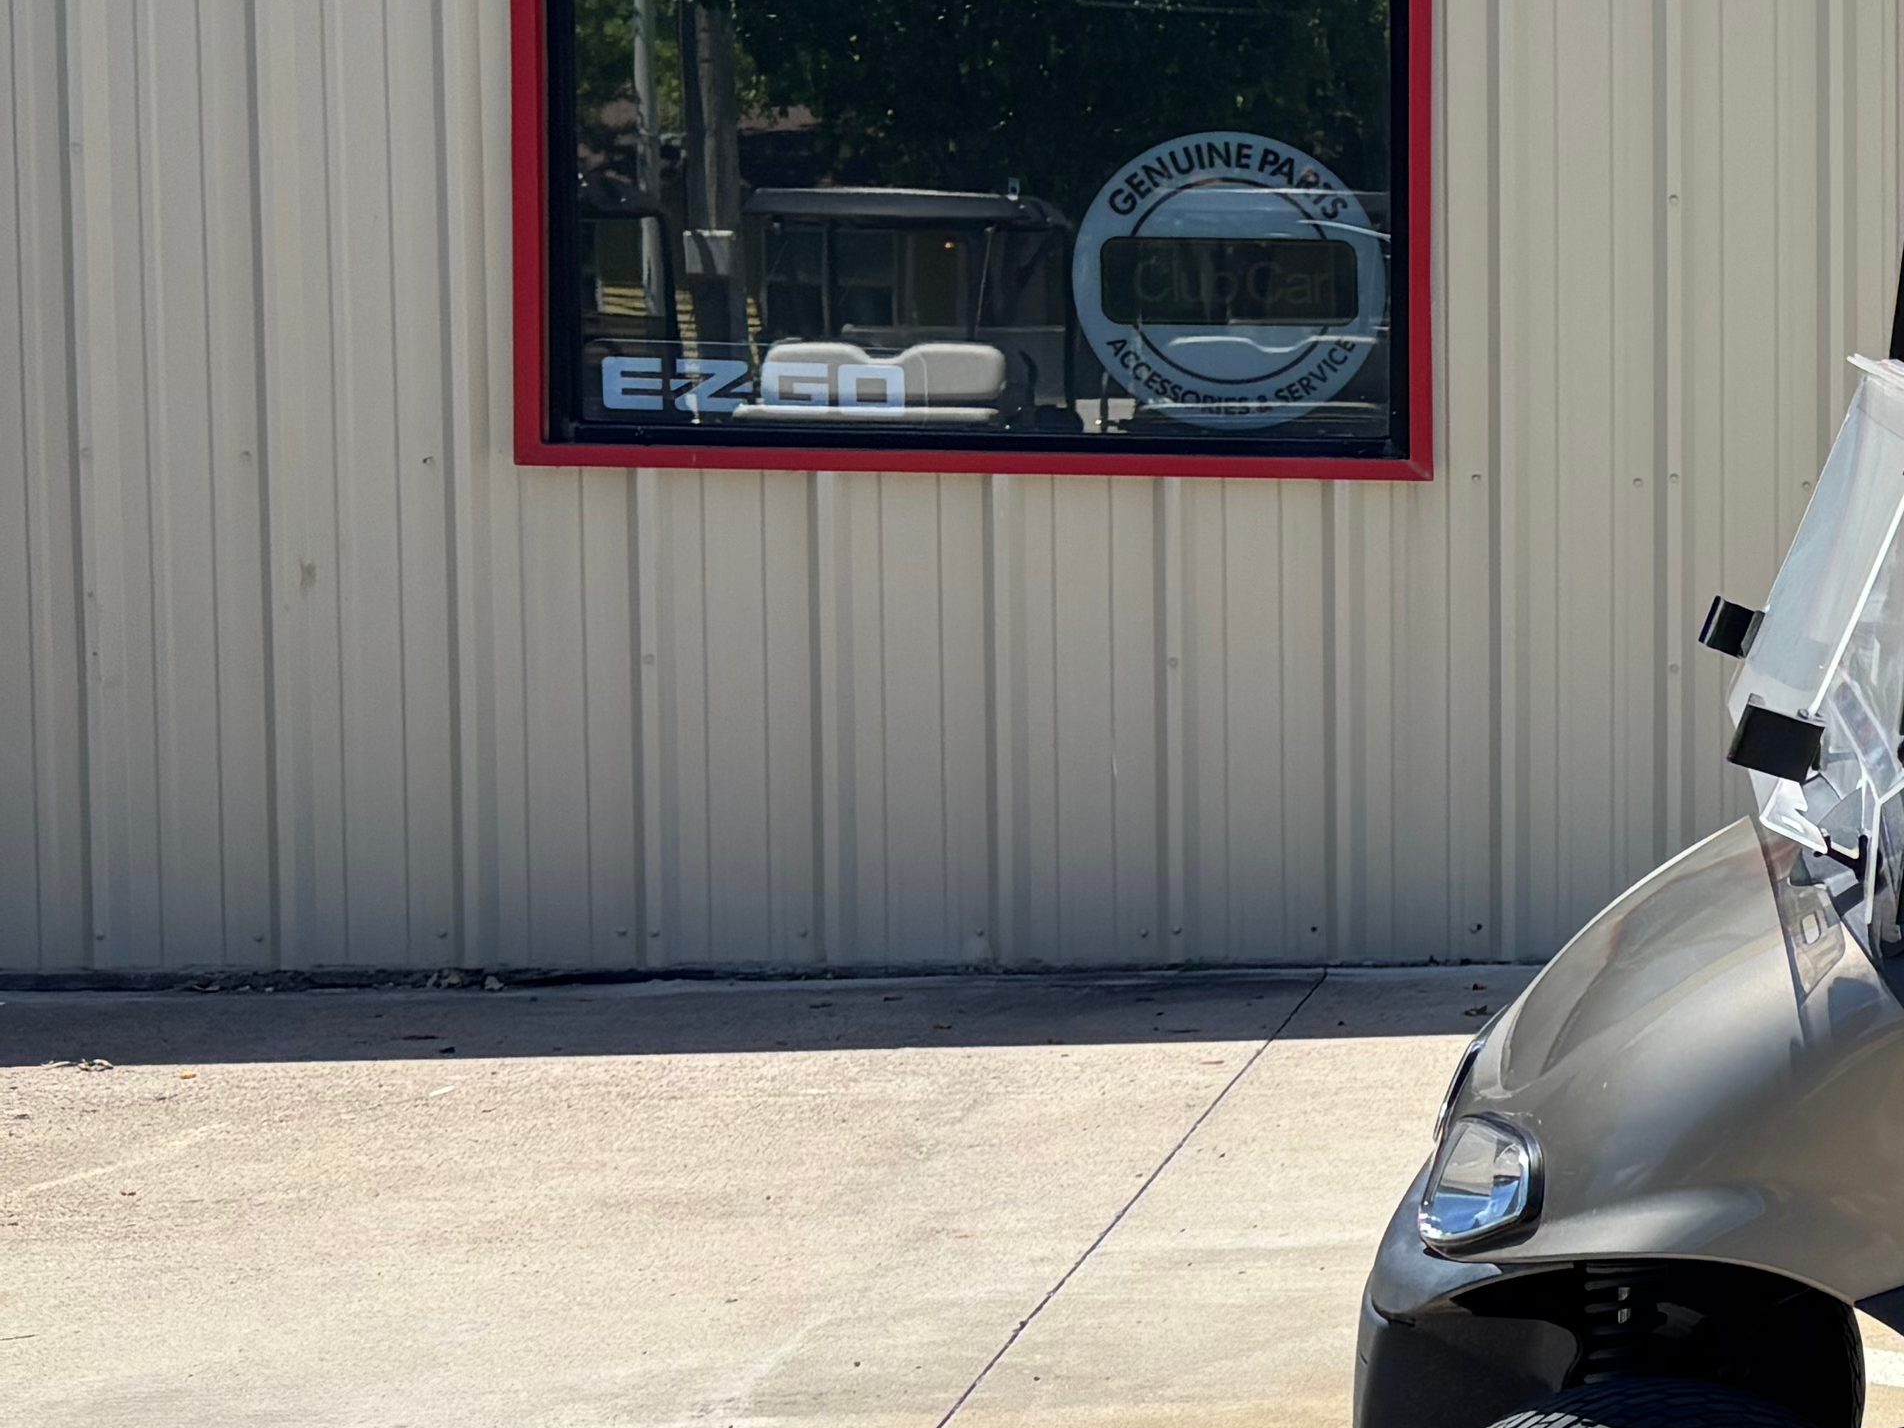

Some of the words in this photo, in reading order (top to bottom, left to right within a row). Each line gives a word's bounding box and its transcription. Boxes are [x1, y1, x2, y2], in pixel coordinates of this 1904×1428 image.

[1107, 142, 1253, 216] GENUINE
[1258, 148, 1348, 220] PARTS
[1107, 339, 1255, 415] ACCESSORIES
[1274, 339, 1356, 404] SERVICE
